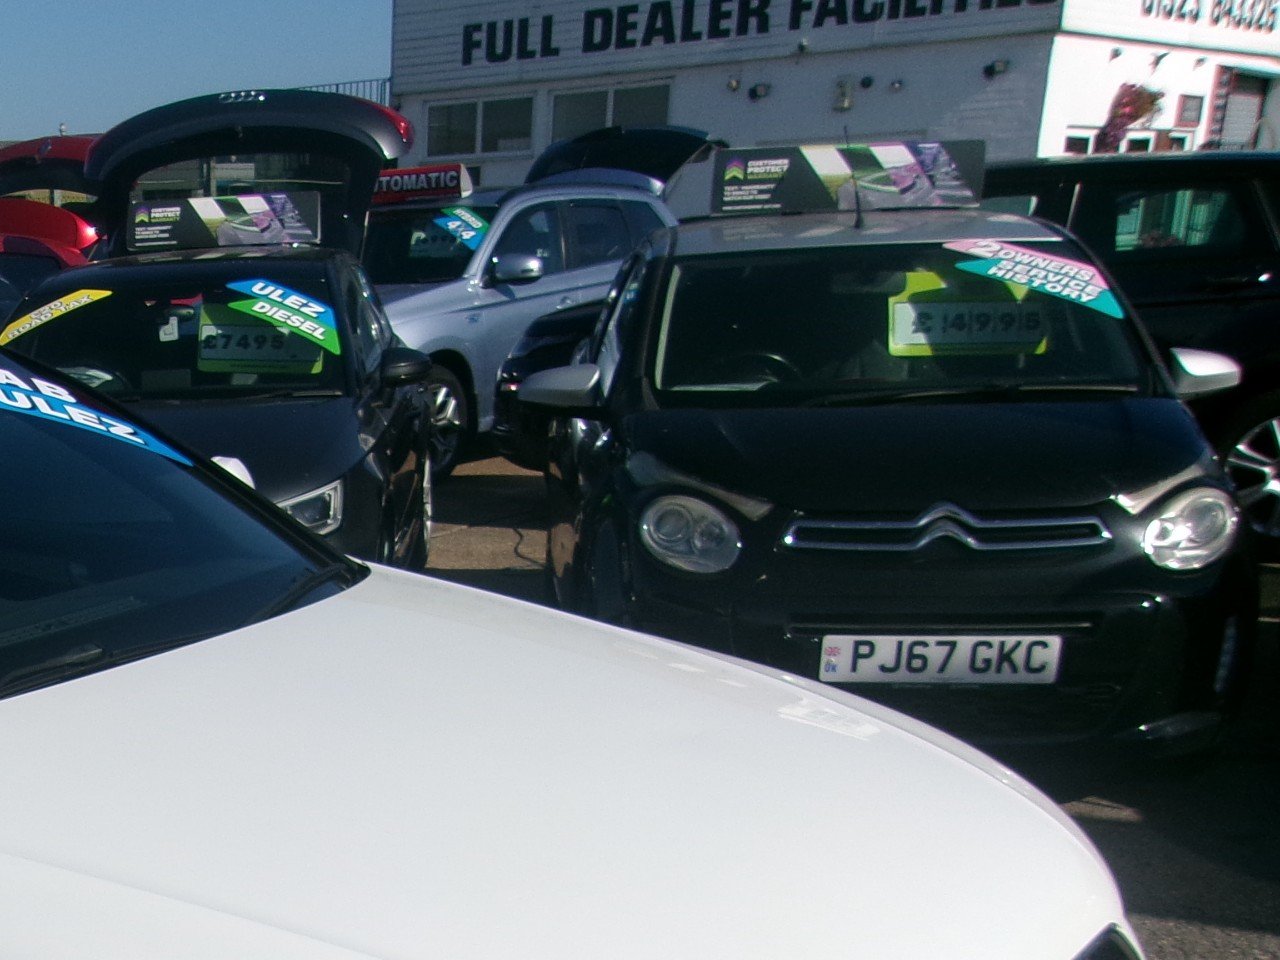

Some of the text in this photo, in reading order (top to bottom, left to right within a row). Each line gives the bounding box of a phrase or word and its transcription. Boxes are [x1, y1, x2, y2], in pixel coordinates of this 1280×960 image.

[462, 15, 560, 66] FULL
[582, 0, 769, 53] DEALER
[971, 240, 1096, 282] 2 OWNERS
[995, 260, 1104, 296] SERVICE
[251, 282, 326, 318] ULEZ
[986, 266, 1097, 303] HISTORY
[252, 301, 326, 340] DIESEL
[202, 332, 286, 350] £7495
[850, 640, 1050, 674] PJ67 GKC
